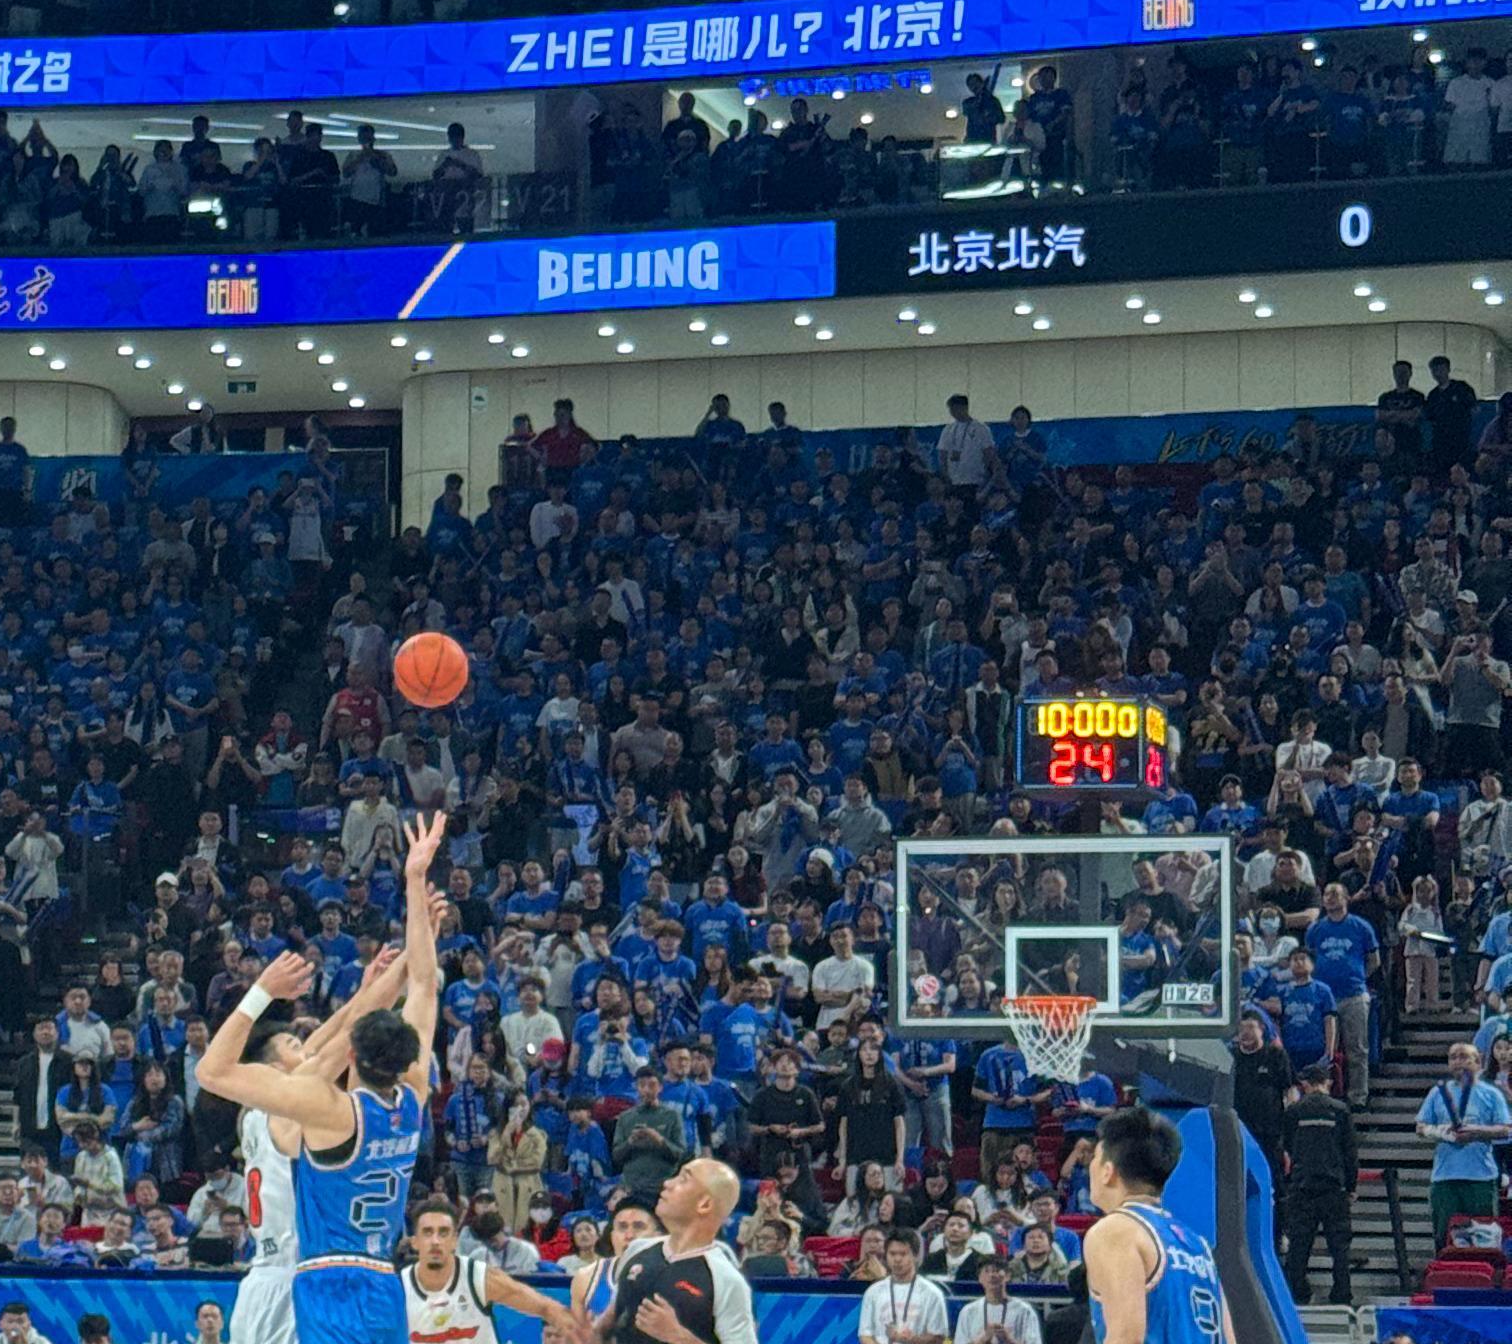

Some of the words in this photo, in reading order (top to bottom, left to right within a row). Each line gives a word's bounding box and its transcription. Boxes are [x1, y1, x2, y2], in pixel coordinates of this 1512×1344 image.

[1338, 205, 1374, 248] 0
[538, 242, 720, 301] BEIJING
[908, 226, 1086, 277] 北京北汽
[1050, 742, 1113, 785] 24
